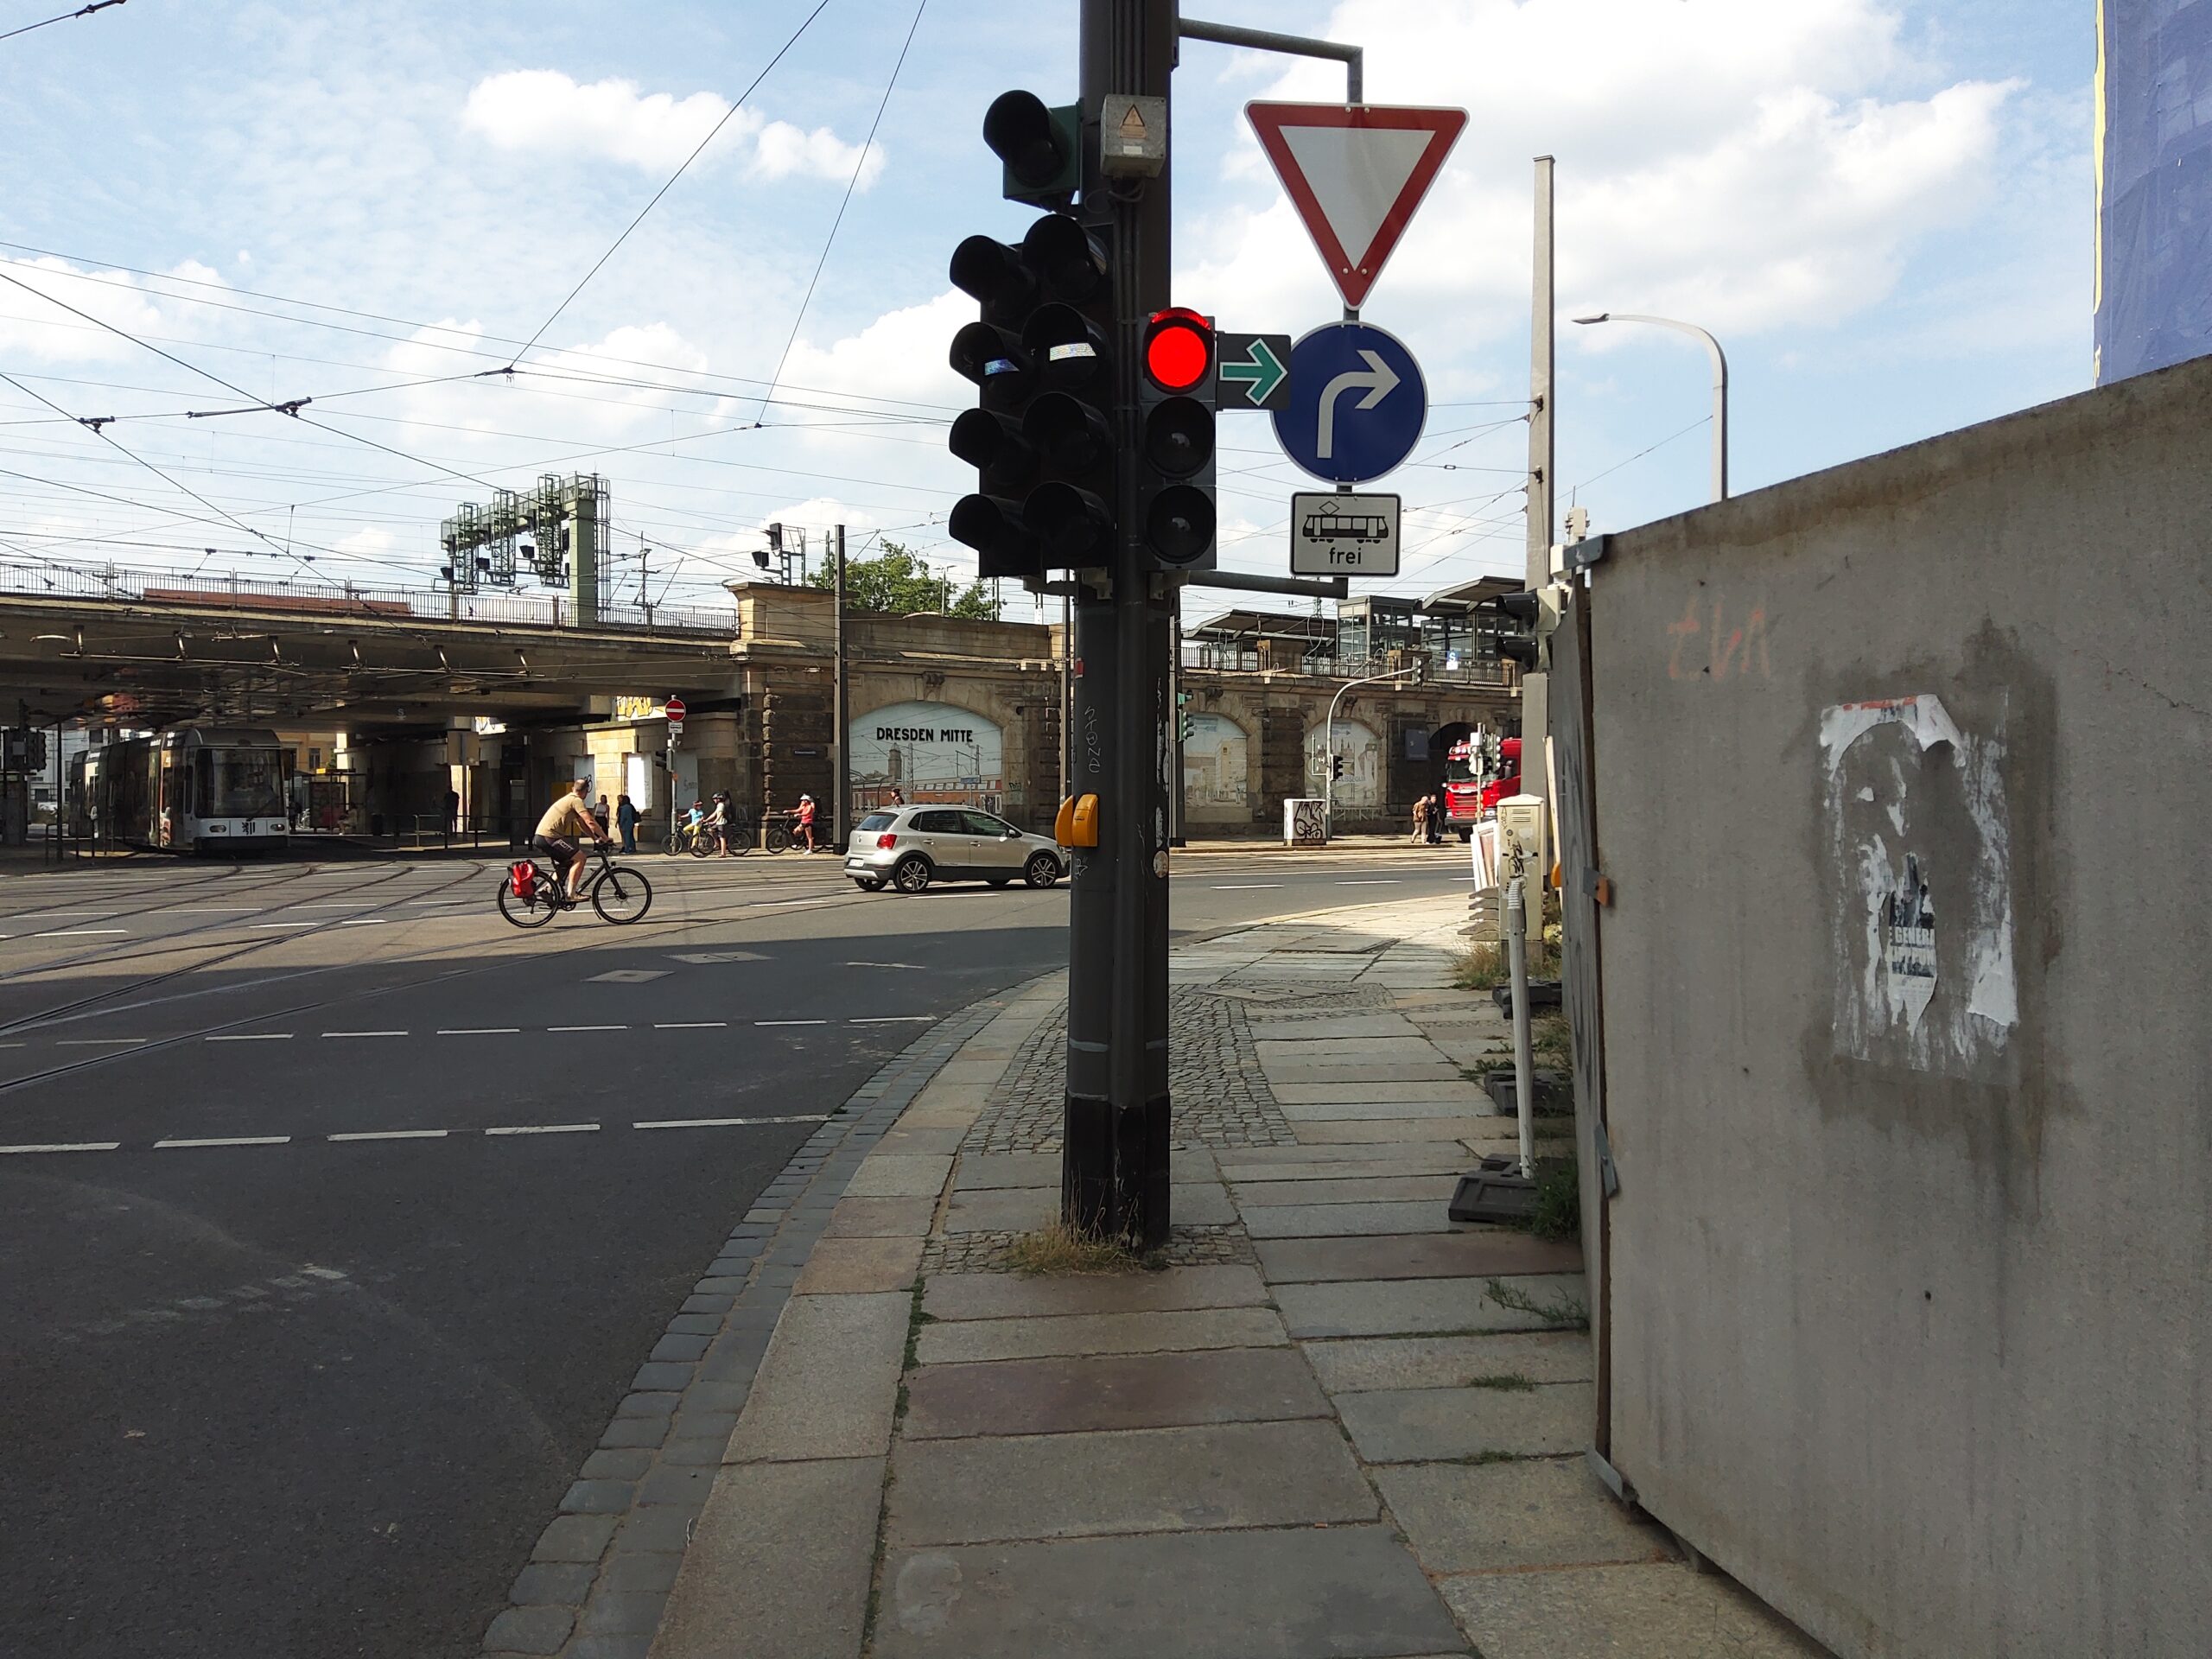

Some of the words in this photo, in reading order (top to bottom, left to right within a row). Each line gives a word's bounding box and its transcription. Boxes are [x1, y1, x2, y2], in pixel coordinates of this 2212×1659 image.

[1329, 547, 1362, 564] frei
[1449, 652, 1456, 662] S
[876, 727, 934, 741] DRESDEN
[940, 729, 973, 742] MITTE
